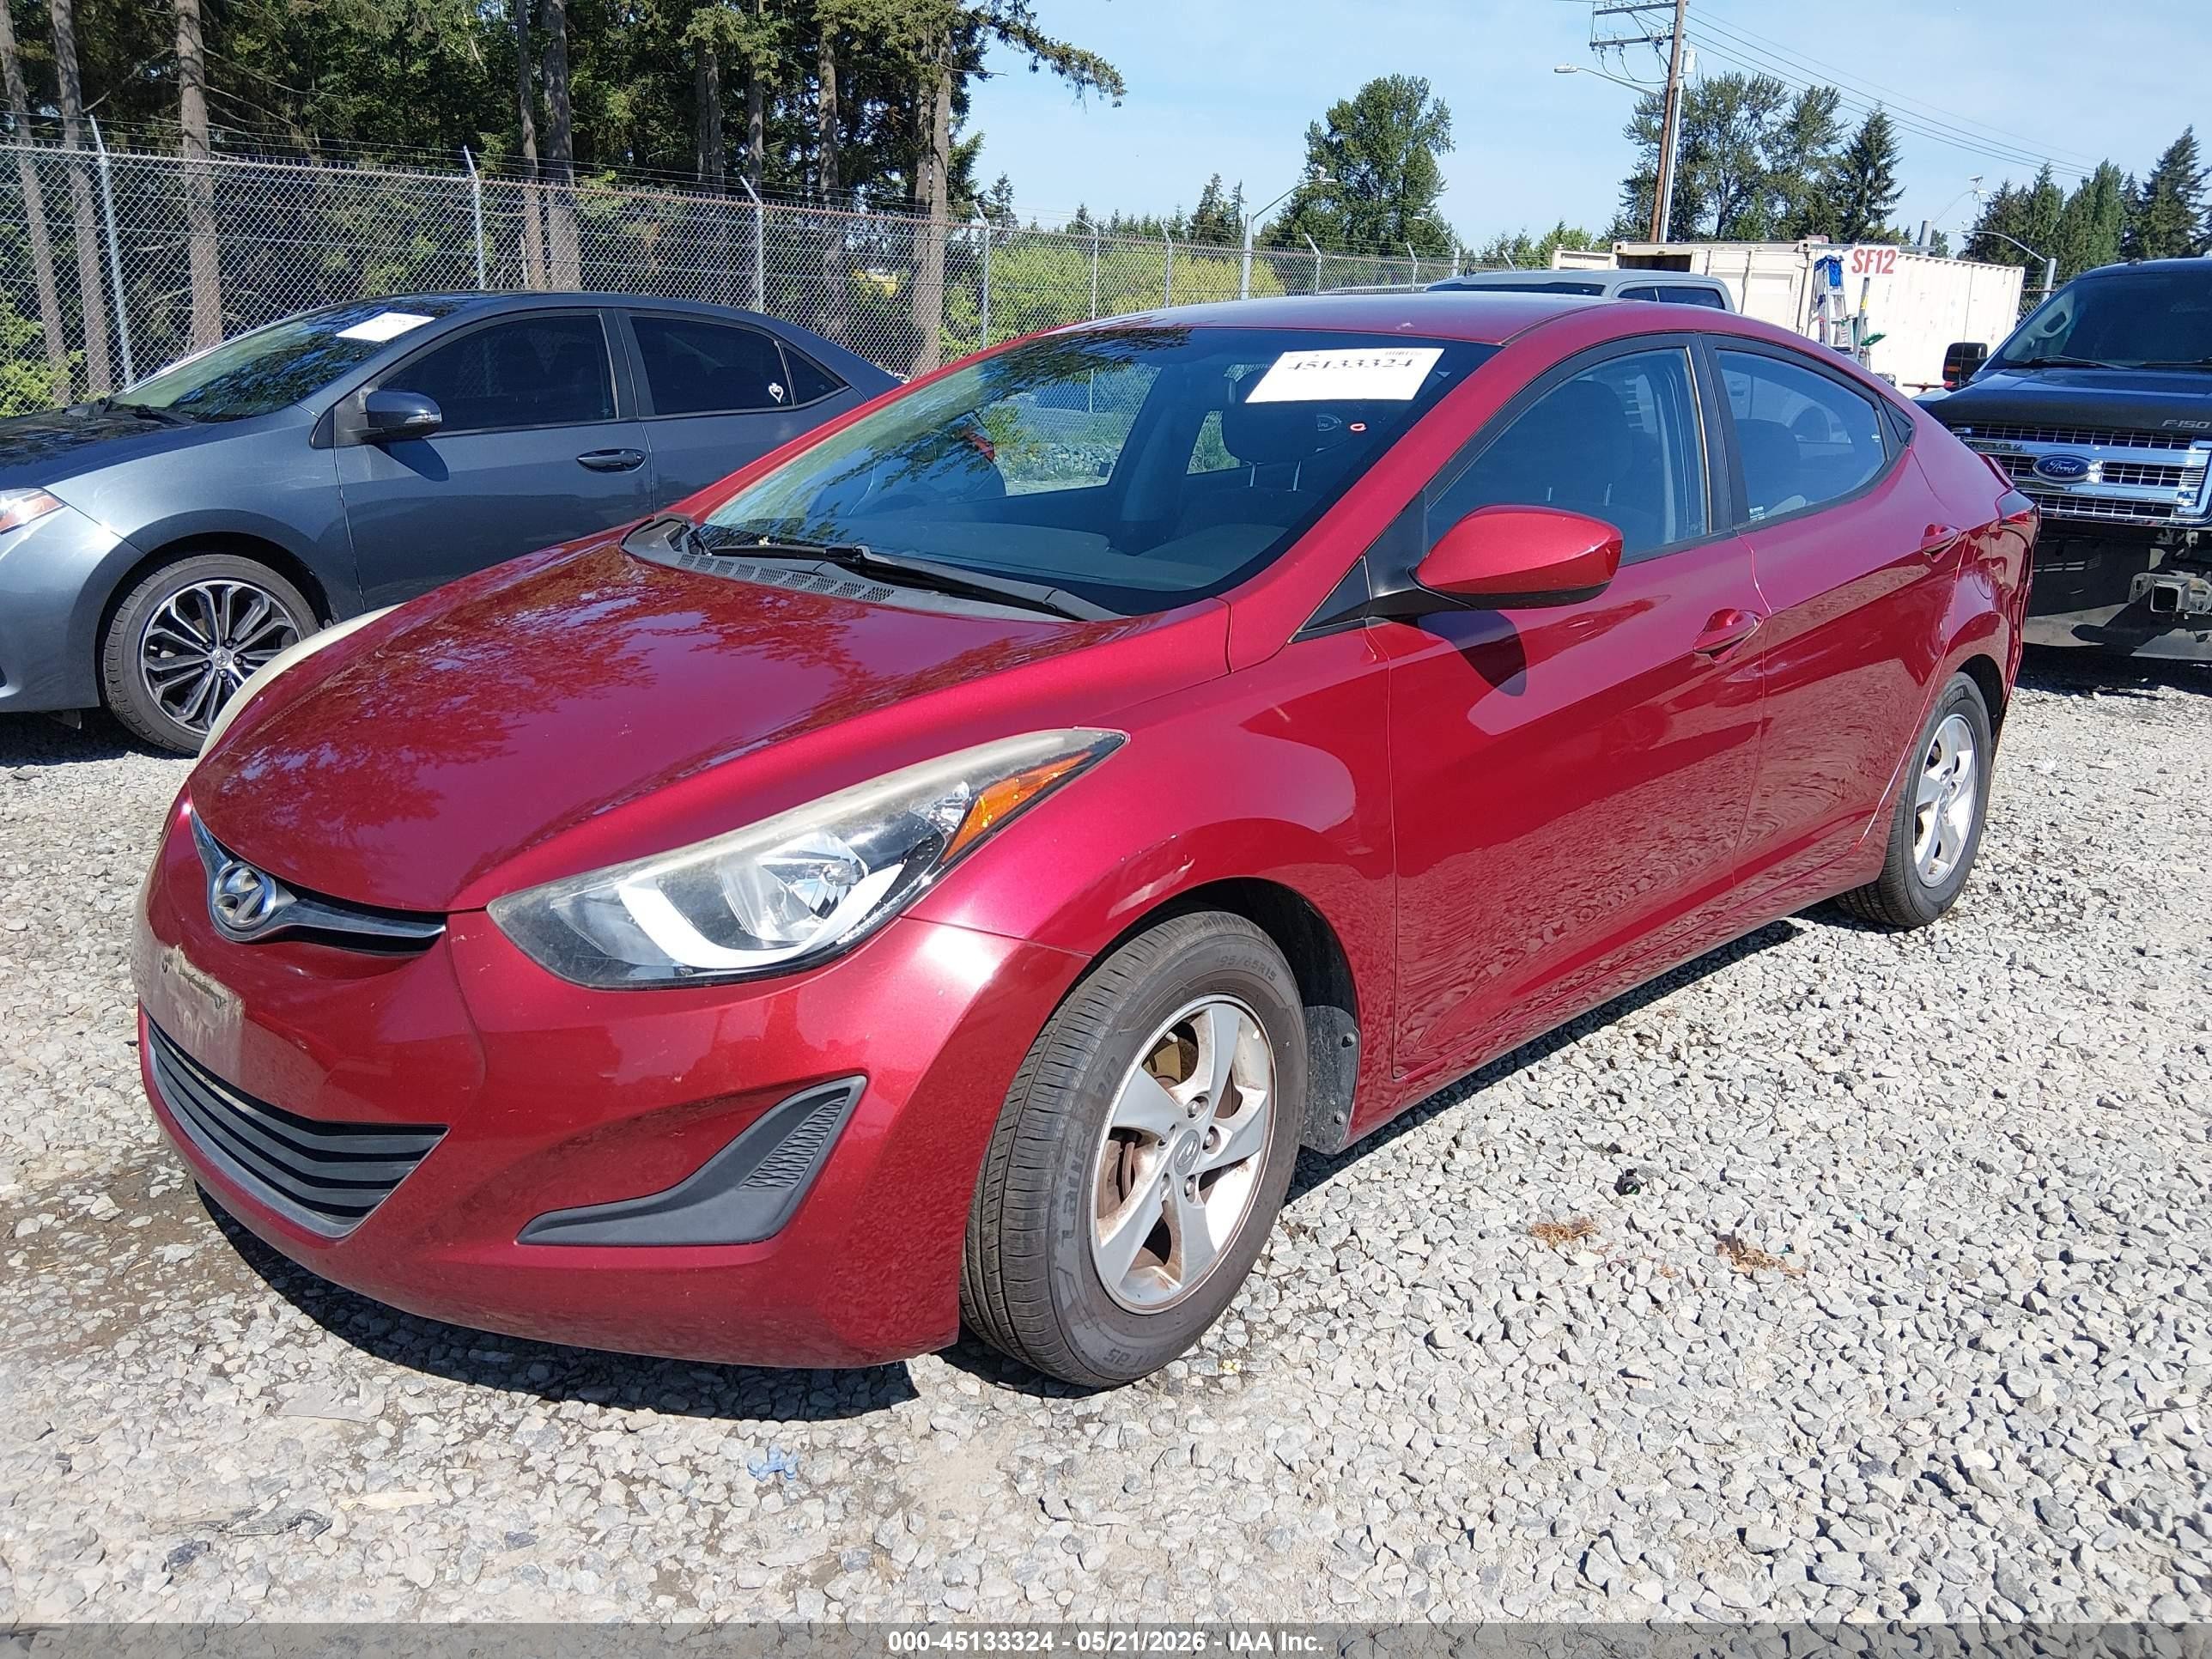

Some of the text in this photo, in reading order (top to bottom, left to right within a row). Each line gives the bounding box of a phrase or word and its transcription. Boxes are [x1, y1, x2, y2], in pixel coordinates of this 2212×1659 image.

[1851, 248, 1897, 274] SF12
[1287, 359, 1413, 370] 45133324
[2161, 419, 2211, 429] F-150
[2045, 460, 2079, 474] Ford
